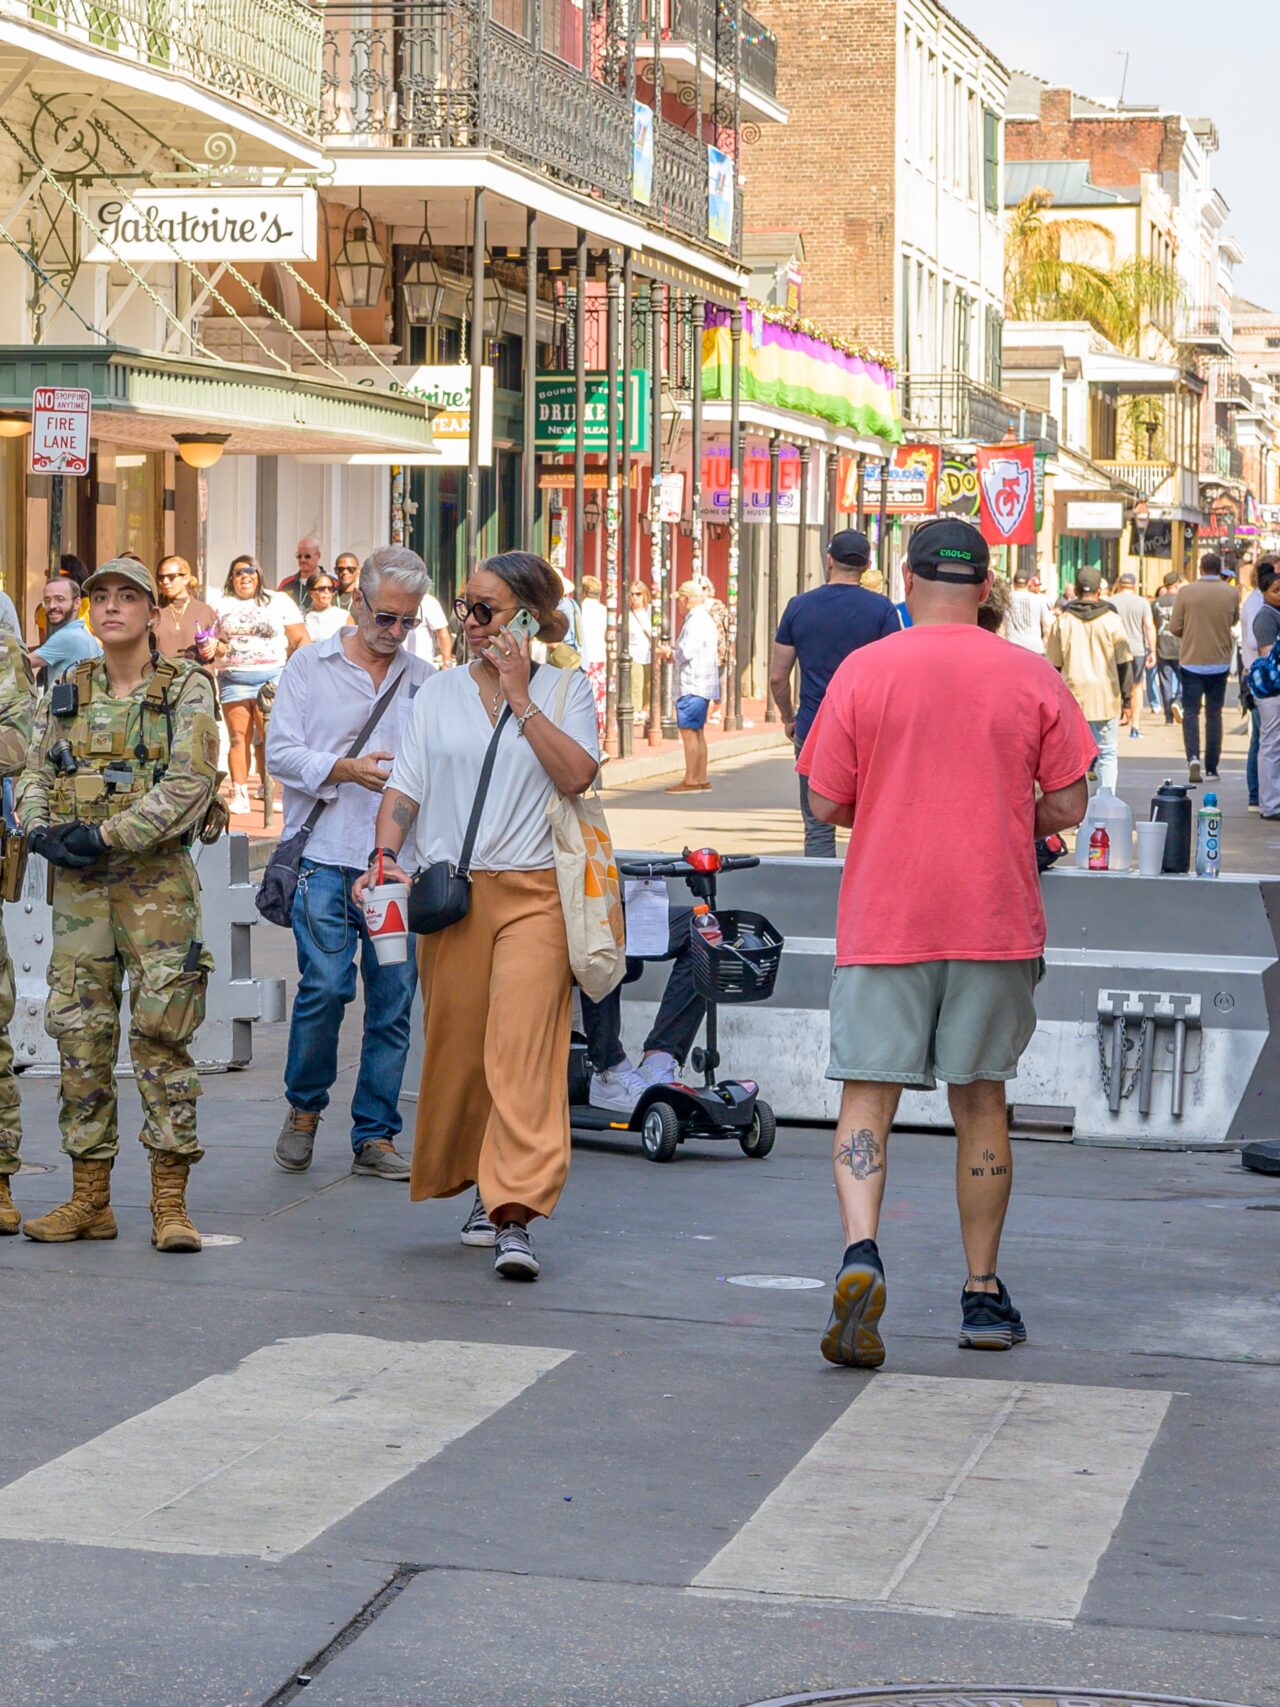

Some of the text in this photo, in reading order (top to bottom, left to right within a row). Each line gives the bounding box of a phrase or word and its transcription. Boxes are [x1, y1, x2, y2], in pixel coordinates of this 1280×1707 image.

[97, 201, 294, 245] Galatoire's
[55, 392, 88, 400] STOPPING
[539, 385, 586, 399] BOURB
[36, 392, 54, 408] NO
[57, 401, 86, 409] ANYTIME
[539, 403, 624, 421] DRIKE
[47, 417, 75, 431] FIRE
[432, 418, 470, 432] TEAK
[548, 426, 619, 434] NEW RLEA
[44, 435, 77, 449] LANE
[701, 458, 806, 489] HUTLE
[713, 491, 794, 508] CUB
[940, 549, 972, 560] EAGLES
[1206, 819, 1219, 861] core
